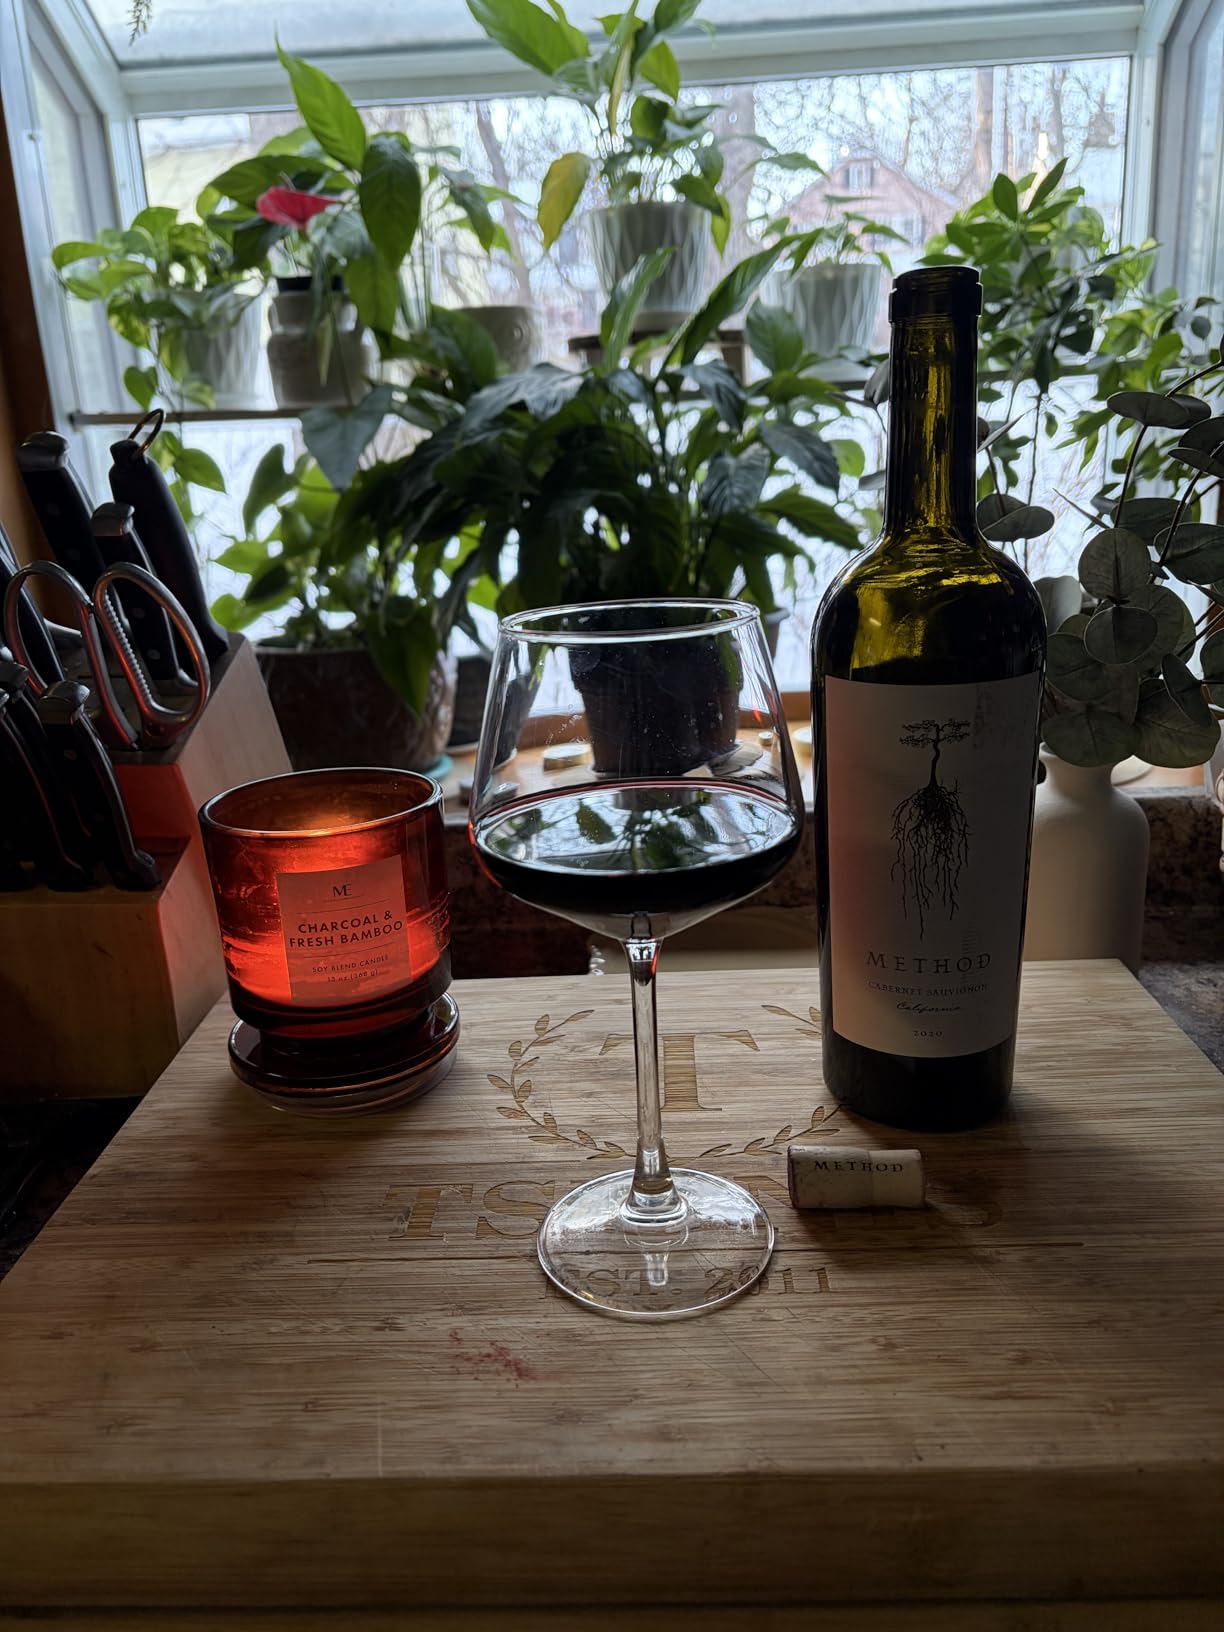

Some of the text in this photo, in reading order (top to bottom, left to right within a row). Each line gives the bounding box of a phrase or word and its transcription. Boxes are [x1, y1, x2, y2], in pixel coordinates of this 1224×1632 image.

[298, 910, 393, 934] CHARCOAL &
[289, 921, 403, 948] FRESH BAMBOO
[331, 962, 357, 971] BLEND
[359, 954, 389, 967] CANDLE
[866, 951, 991, 974] METHOD
[868, 980, 988, 996] CABERNET SAUVIGNON
[896, 1001, 961, 1013] California
[913, 1030, 943, 1038] 2020
[813, 1161, 904, 1172] METHOD
